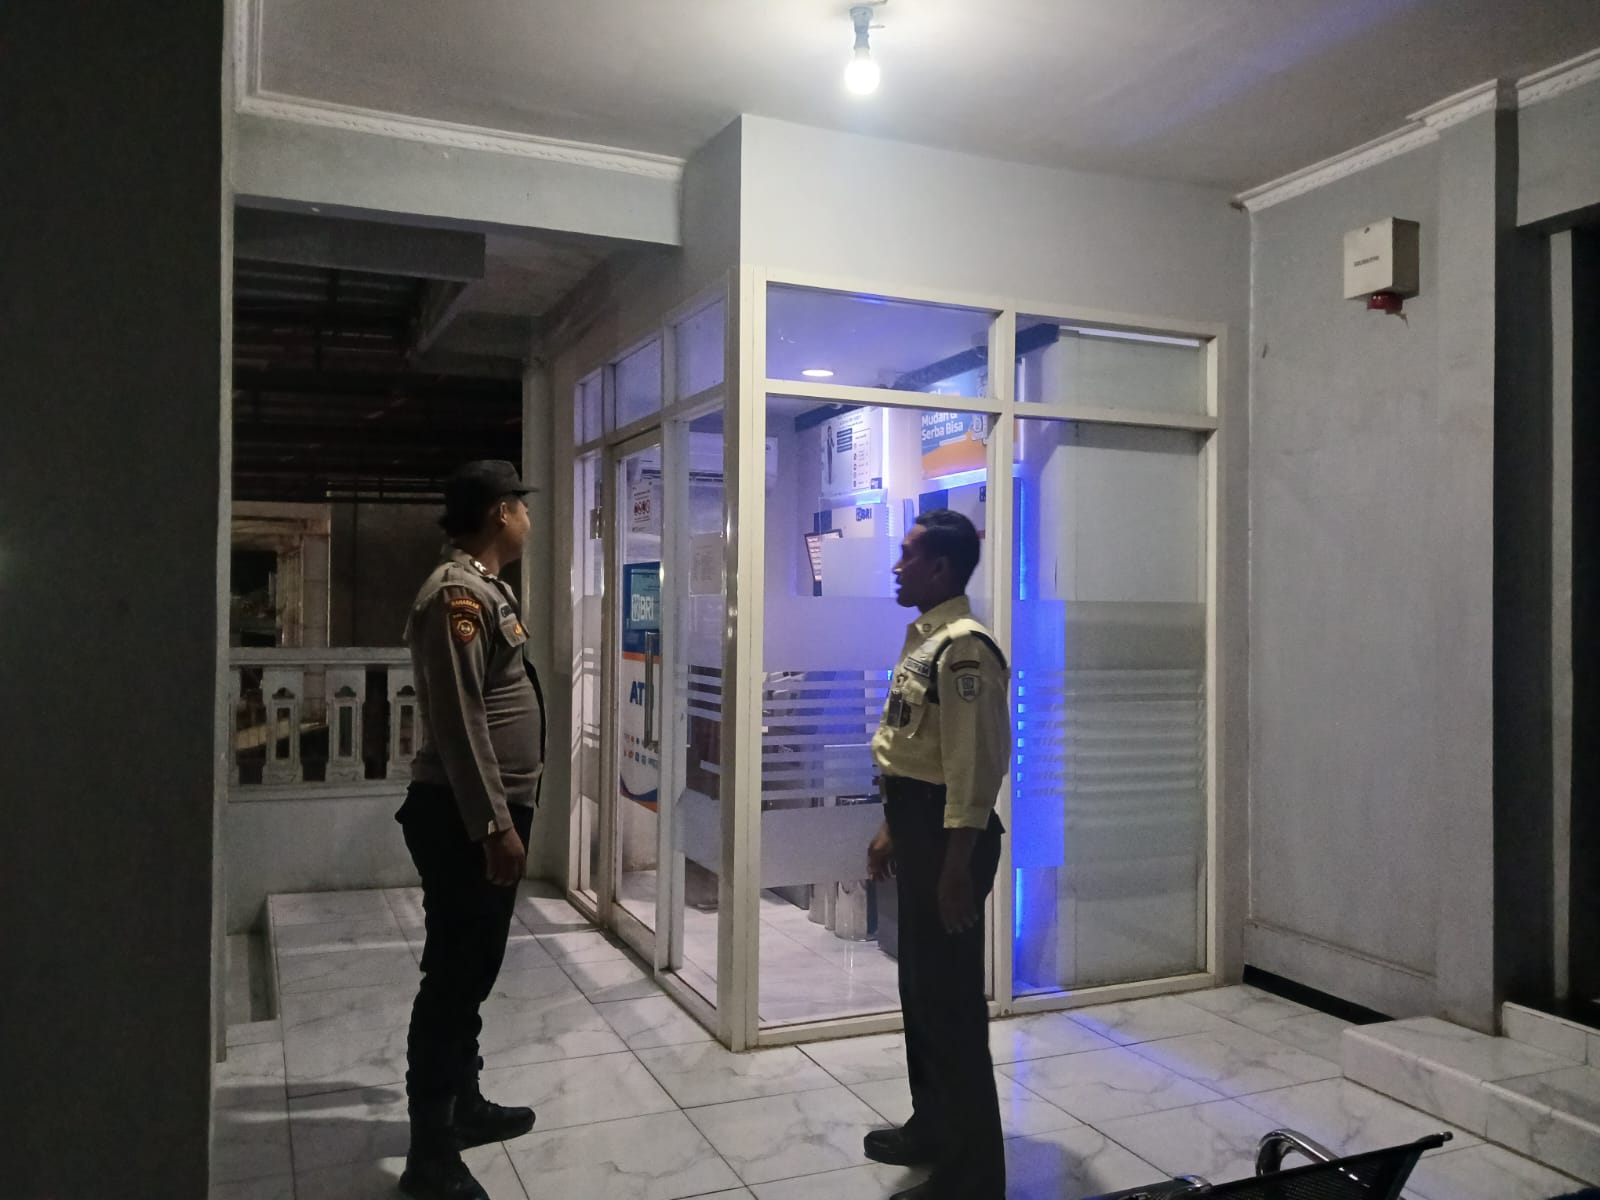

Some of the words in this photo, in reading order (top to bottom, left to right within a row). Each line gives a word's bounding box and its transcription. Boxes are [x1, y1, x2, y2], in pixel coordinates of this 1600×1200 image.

[921, 426, 945, 441] Serba
[945, 421, 964, 435] Bisa
[640, 596, 654, 620] BRI
